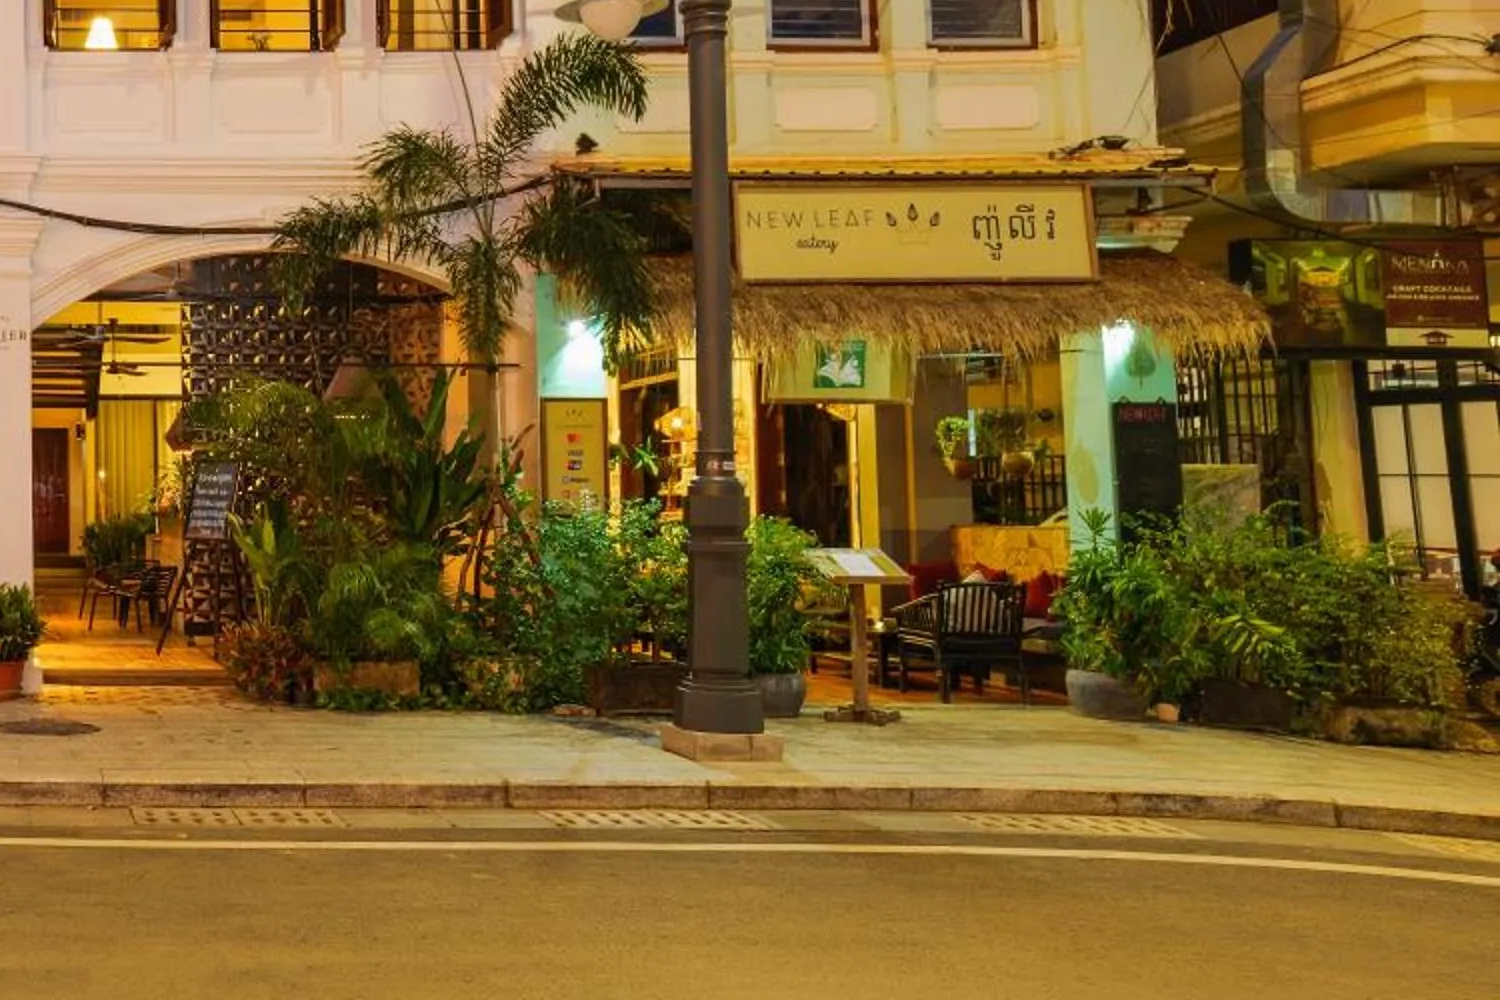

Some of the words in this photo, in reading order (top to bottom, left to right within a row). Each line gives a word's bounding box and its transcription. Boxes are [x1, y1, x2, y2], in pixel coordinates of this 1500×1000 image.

[747, 210, 804, 230] NEW
[813, 208, 875, 228] LEAF
[795, 236, 838, 254] eatery
